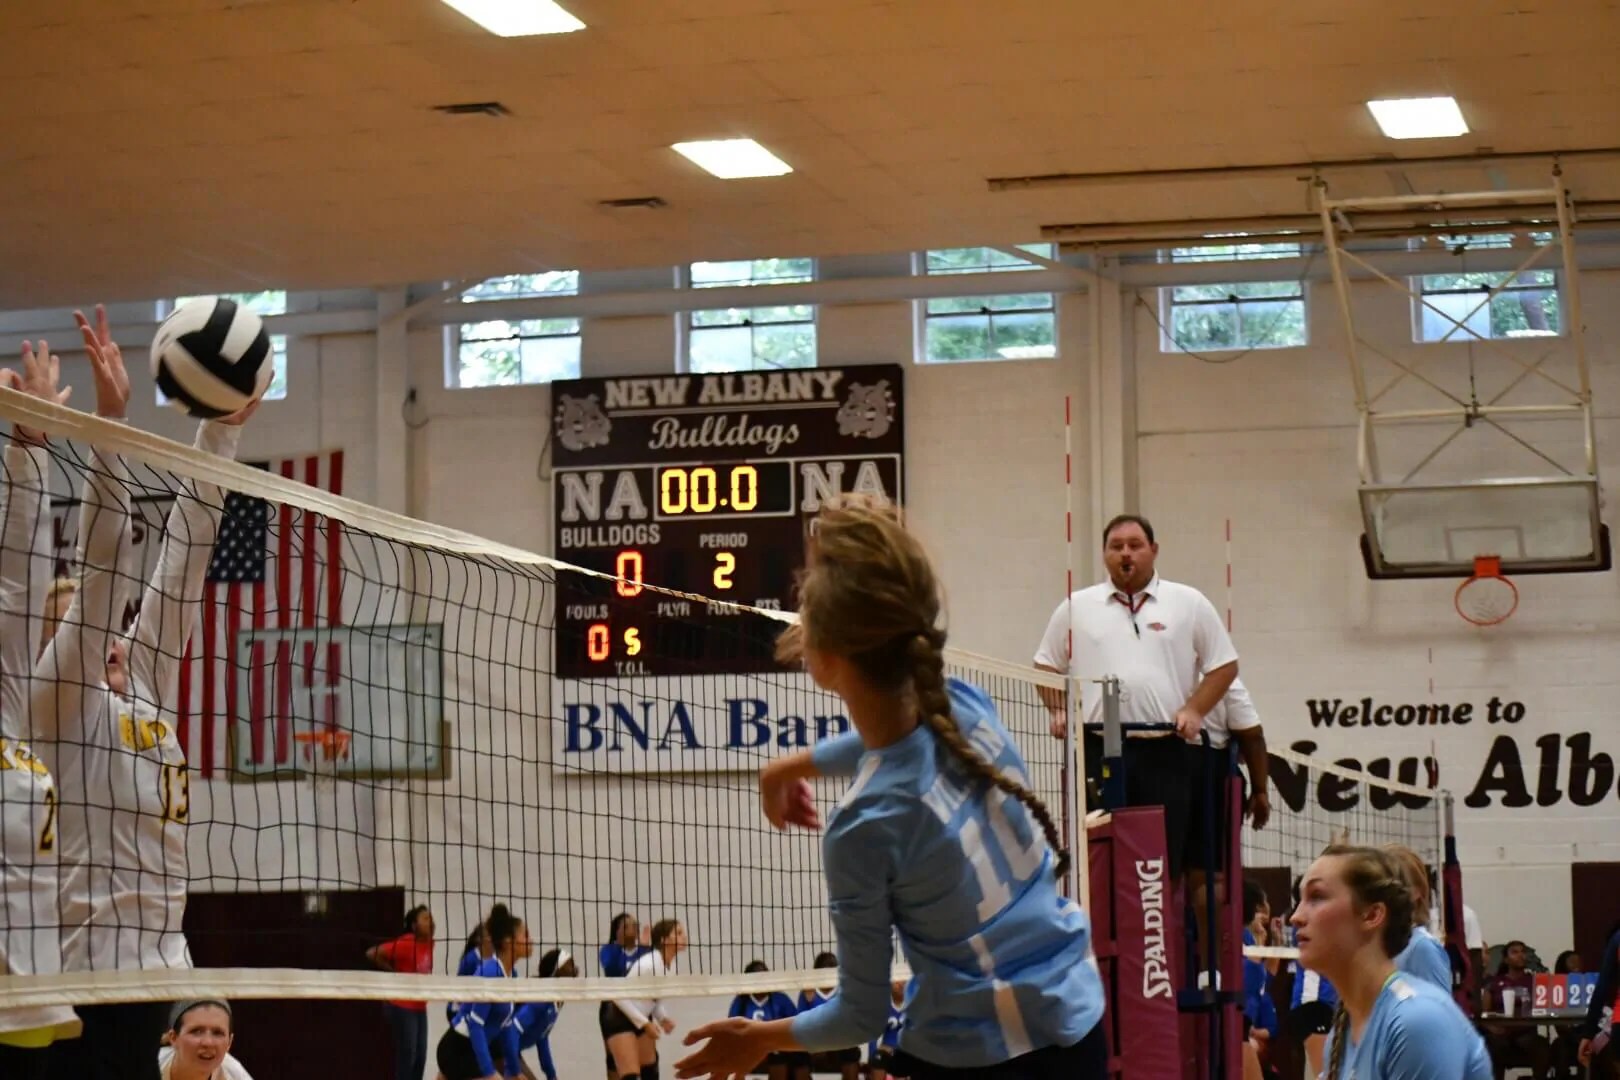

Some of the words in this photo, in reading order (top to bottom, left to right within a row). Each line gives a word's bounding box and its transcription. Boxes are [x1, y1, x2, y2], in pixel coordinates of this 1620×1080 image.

[604, 377, 690, 408] NEW
[698, 370, 844, 403] ALBANY
[648, 414, 800, 455] Bulldogs
[560, 470, 648, 522] NA
[661, 465, 757, 515] 00.0
[801, 460, 891, 513] NA
[560, 525, 661, 548] BULLDOGS
[699, 533, 748, 549] PERIOD
[616, 551, 643, 597] 0
[713, 552, 736, 590] 2
[566, 604, 609, 619] FOULS
[658, 602, 691, 617] PLYR
[588, 624, 609, 661] 0
[563, 701, 701, 752] BNA
[723, 698, 849, 748] Ban
[1306, 698, 1473, 728] Welcome
[1487, 697, 1525, 724] to
[1464, 732, 1620, 808] Alb
[1136, 856, 1173, 999] SPALDING
